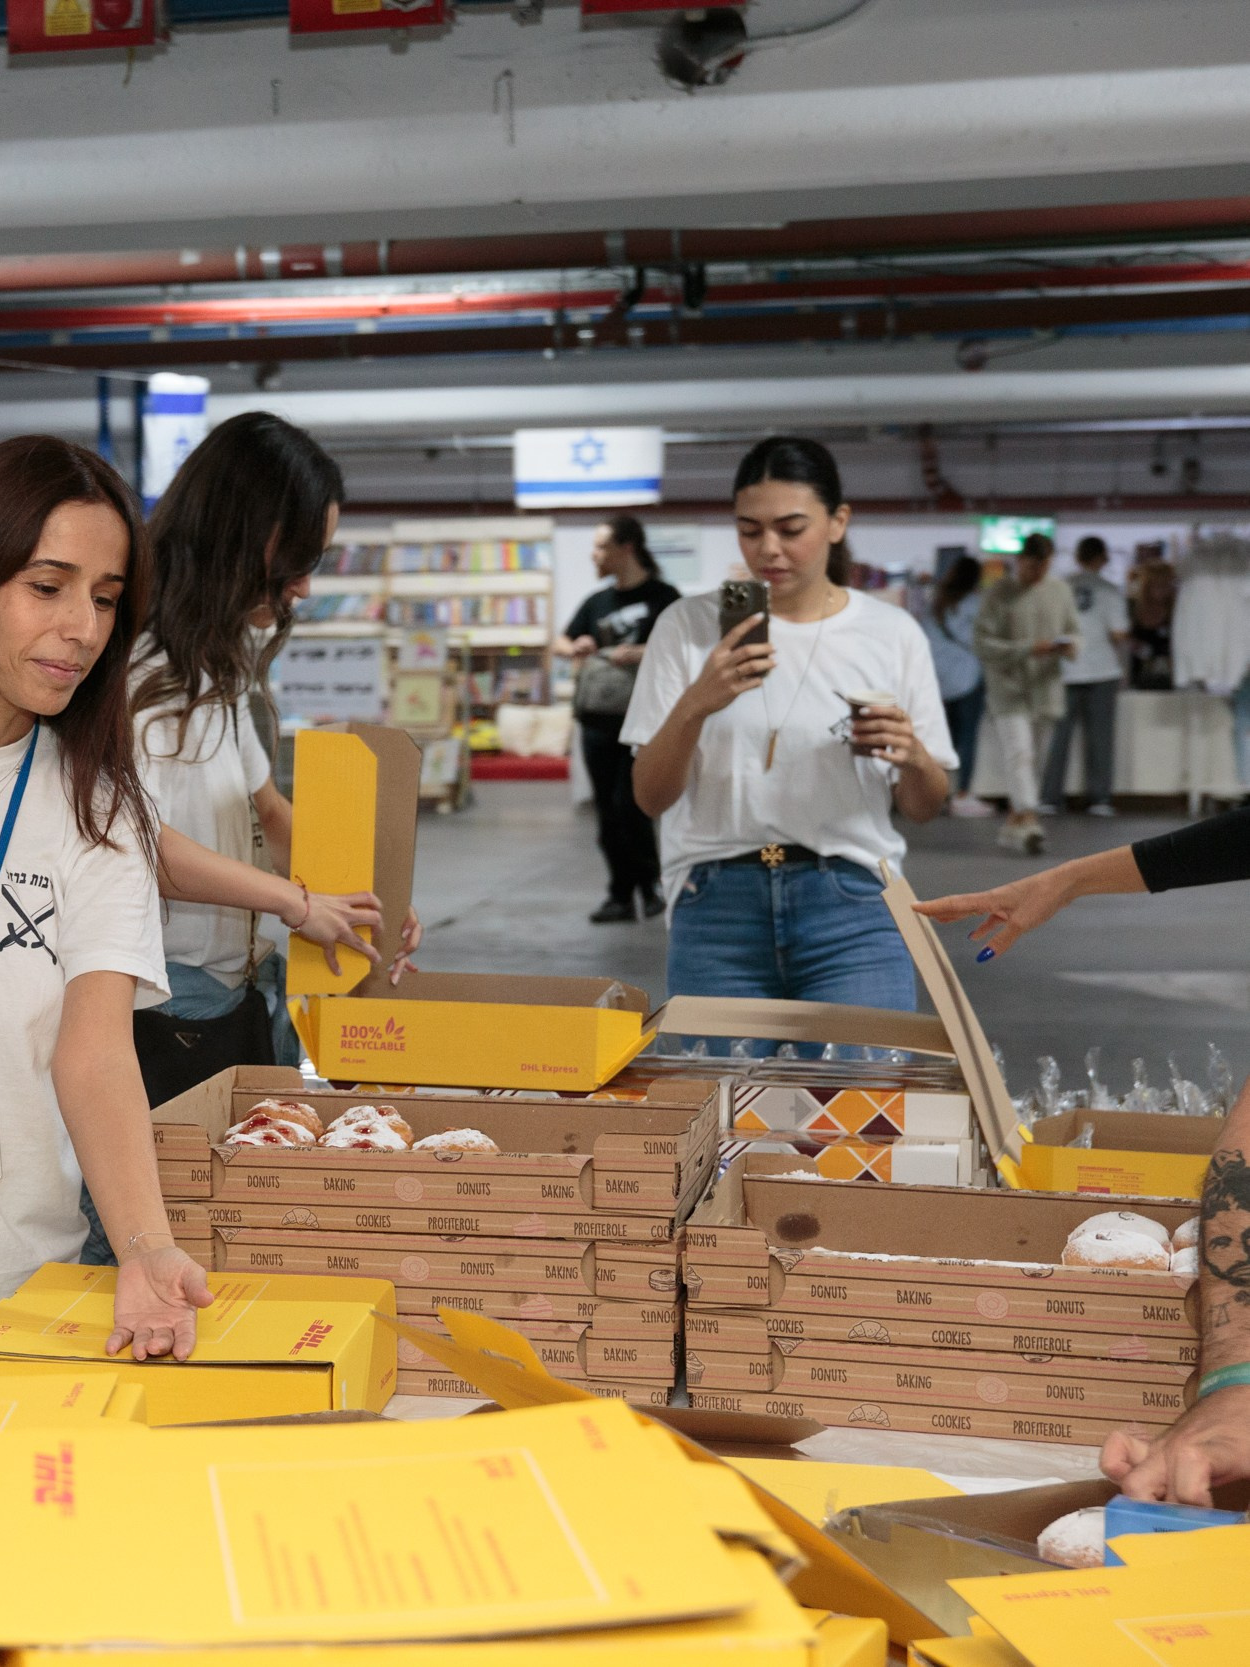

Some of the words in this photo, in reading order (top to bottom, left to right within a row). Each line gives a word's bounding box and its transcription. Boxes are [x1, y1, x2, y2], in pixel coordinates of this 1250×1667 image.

[341, 1025, 382, 1039] 100%
[340, 1039, 406, 1051] RECYCLABLE
[520, 1063, 540, 1072] DHL
[541, 1064, 579, 1074] Express
[247, 1175, 280, 1189] DONUTS
[323, 1177, 356, 1191] BAKING
[456, 1182, 491, 1196] DONUTS
[541, 1184, 575, 1199] BAKING
[605, 1179, 640, 1194] BAKING
[355, 1214, 392, 1228] COOKIES
[427, 1216, 481, 1232] PROFITEROLE
[573, 1222, 628, 1237] PROFITEROLE
[250, 1253, 284, 1267] DONUTS
[327, 1255, 360, 1270] BAKING
[460, 1261, 495, 1276] DONUTS
[545, 1265, 579, 1279] BAKING
[810, 1284, 848, 1300] DONUTS
[896, 1289, 932, 1306] BAKING
[1046, 1299, 1085, 1315] DONUTS
[1142, 1305, 1181, 1321] BAKING
[641, 1309, 676, 1324] DONUTS
[685, 1318, 719, 1334] BAKING
[766, 1320, 804, 1334] COOKIES
[931, 1329, 972, 1346] COOKIES
[1013, 1335, 1072, 1353] PROFITEROLE
[541, 1348, 575, 1363] BAKING
[603, 1347, 638, 1362] BAKING
[810, 1367, 848, 1384] DONUTS
[896, 1373, 932, 1390] BAKING
[1046, 1384, 1085, 1401] DONUTS
[1142, 1391, 1180, 1408] BAKING
[765, 1401, 804, 1417] COOKIES
[931, 1414, 971, 1431] COOKIES
[1013, 1420, 1072, 1439] PROFITEROLE
